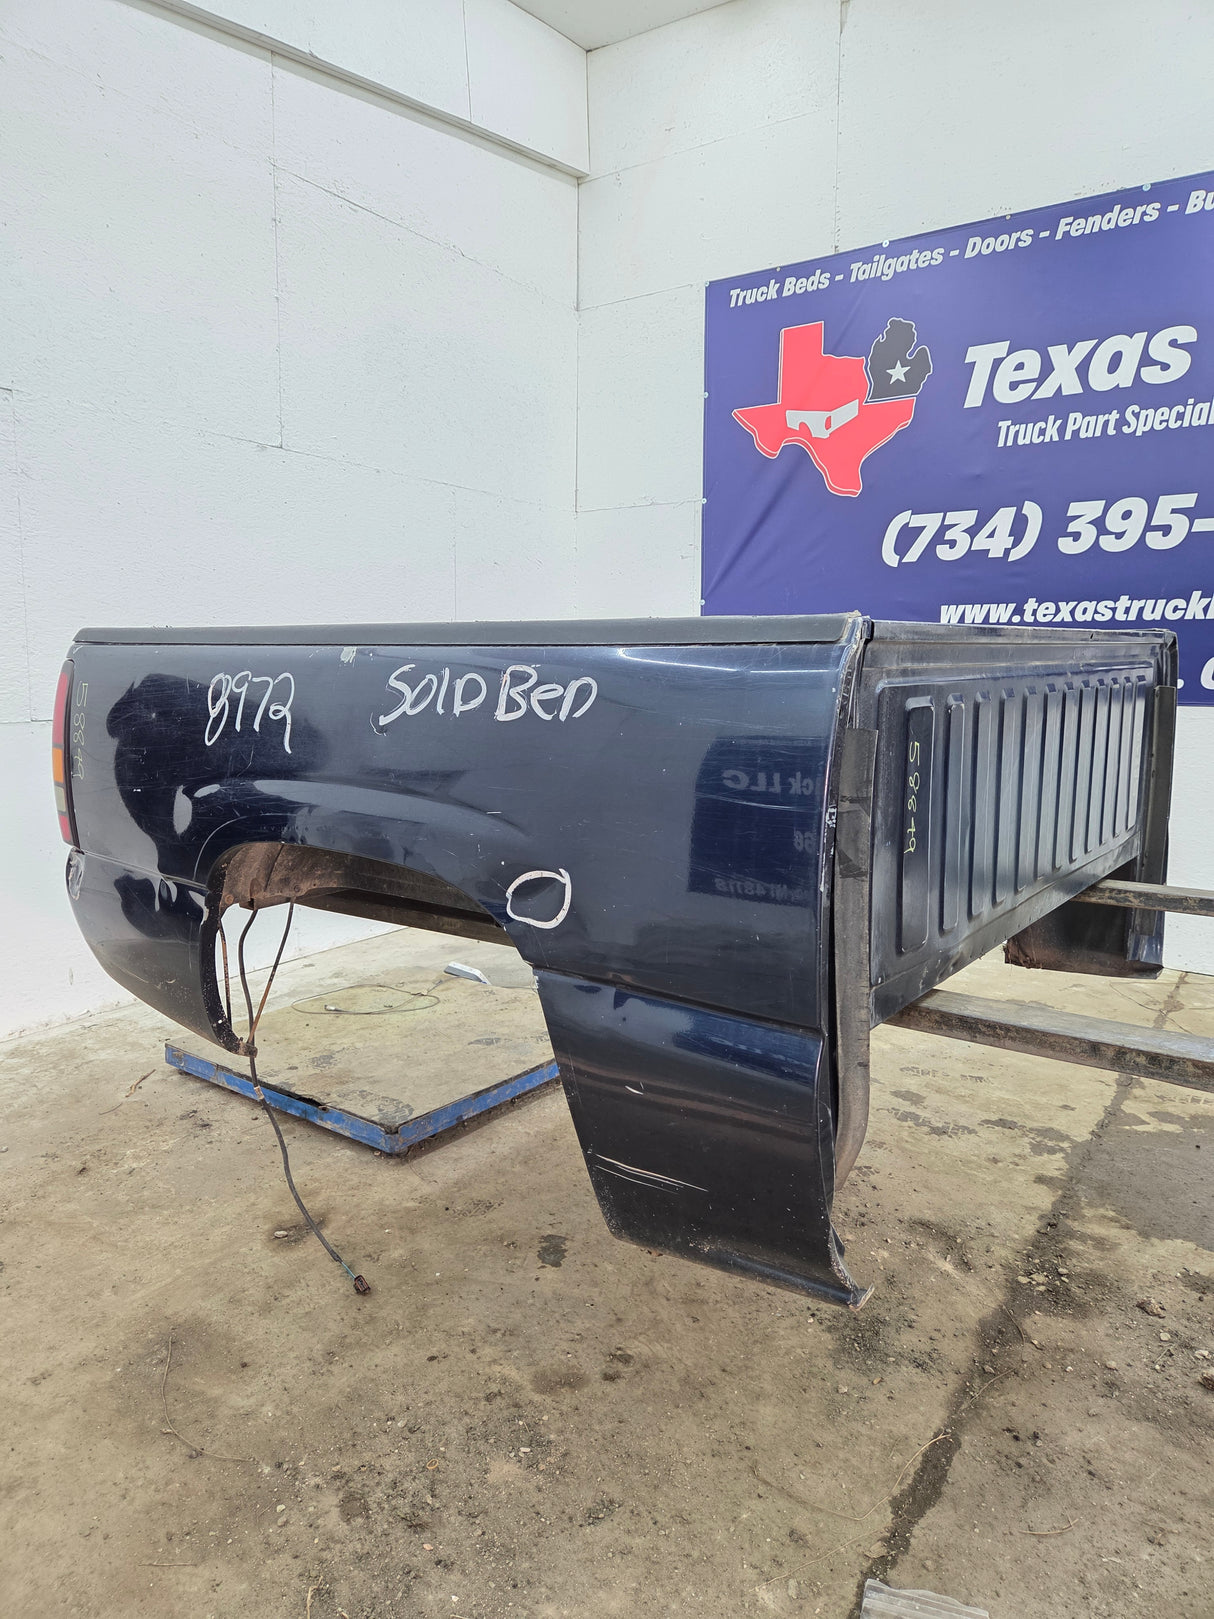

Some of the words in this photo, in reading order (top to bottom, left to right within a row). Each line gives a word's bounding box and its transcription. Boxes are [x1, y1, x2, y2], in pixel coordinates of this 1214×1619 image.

[729, 278, 779, 307] Truck
[782, 269, 831, 297] Beds
[849, 248, 944, 284] Tailgates
[964, 226, 1034, 259] Doors
[1055, 201, 1161, 241] Fenders
[963, 325, 1198, 409] Texas
[997, 417, 1062, 448] Truck
[1065, 409, 1120, 440] Part
[881, 500, 1043, 568] (734)
